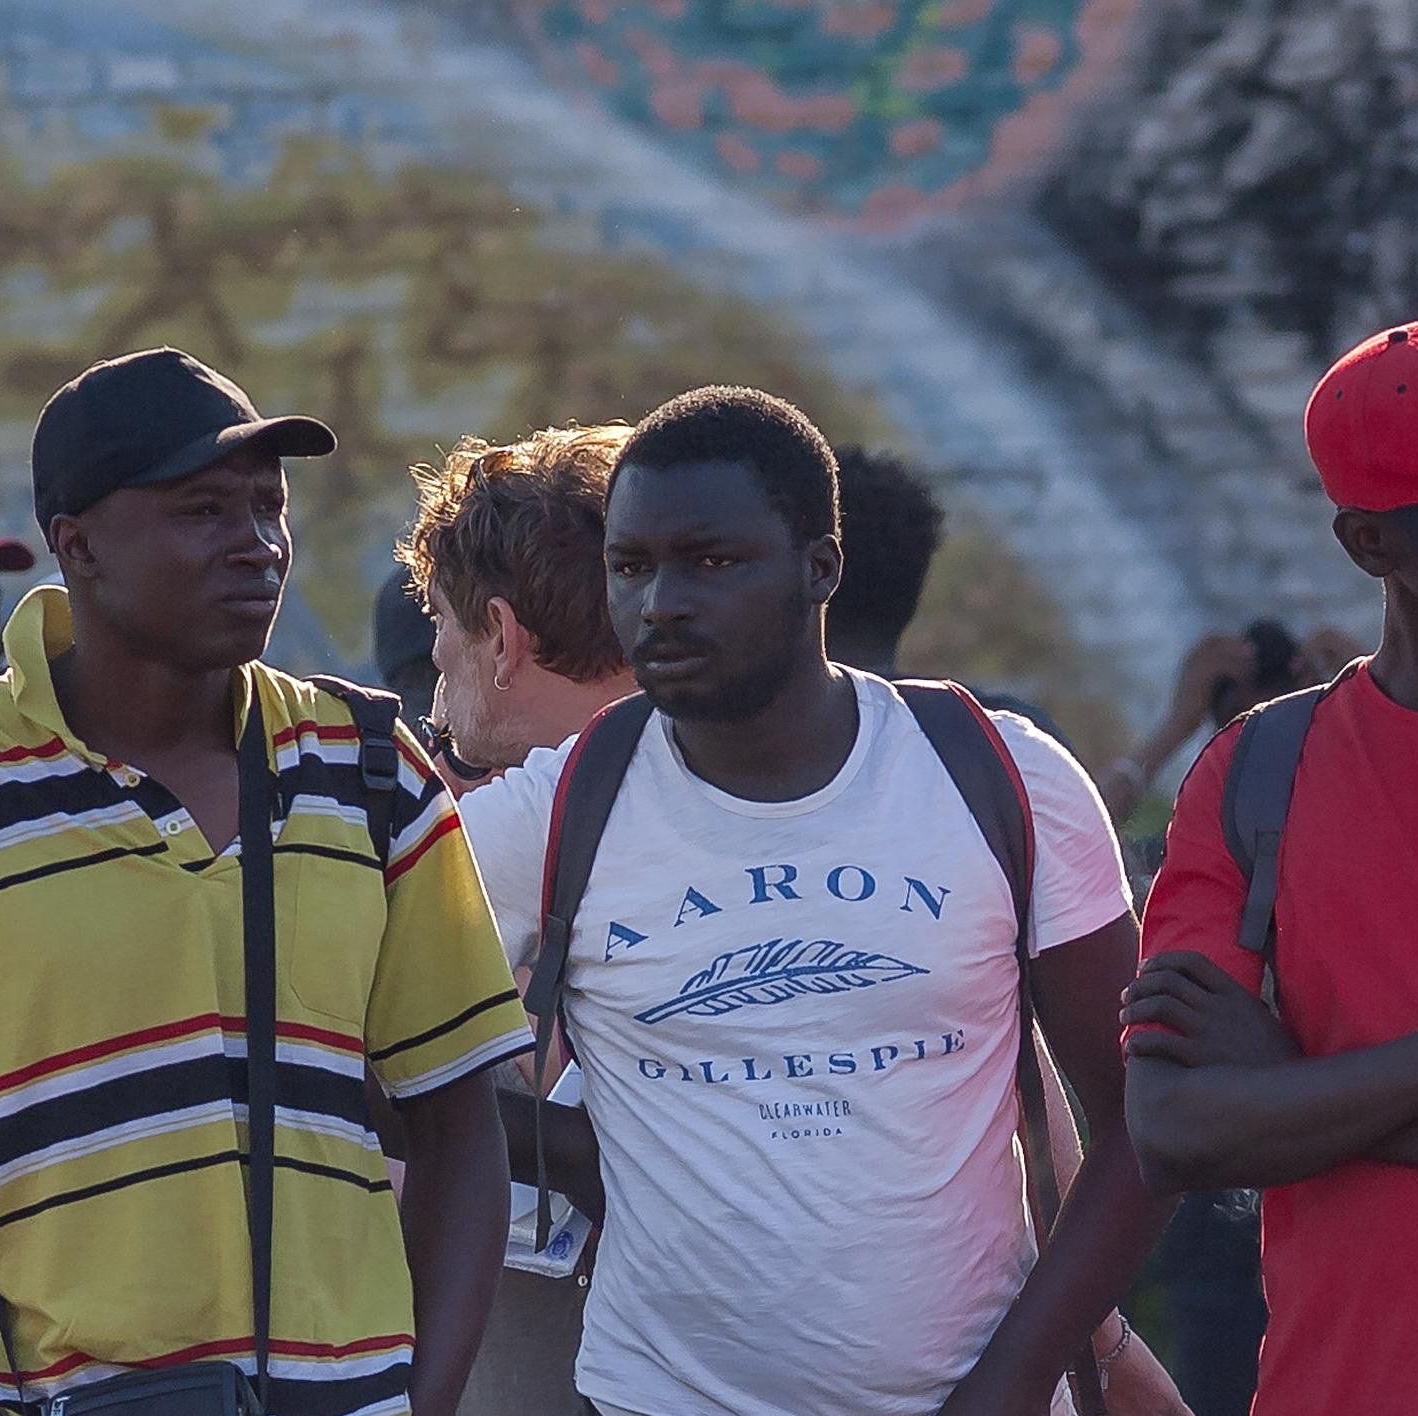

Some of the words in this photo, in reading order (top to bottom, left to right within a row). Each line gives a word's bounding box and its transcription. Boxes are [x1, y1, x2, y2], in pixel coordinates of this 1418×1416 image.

[604, 863, 952, 962] AARON
[638, 1029, 966, 1084] GILLESPIE
[758, 1100, 852, 1120] CLEARWATER
[771, 1127, 843, 1140] FLORIDA
